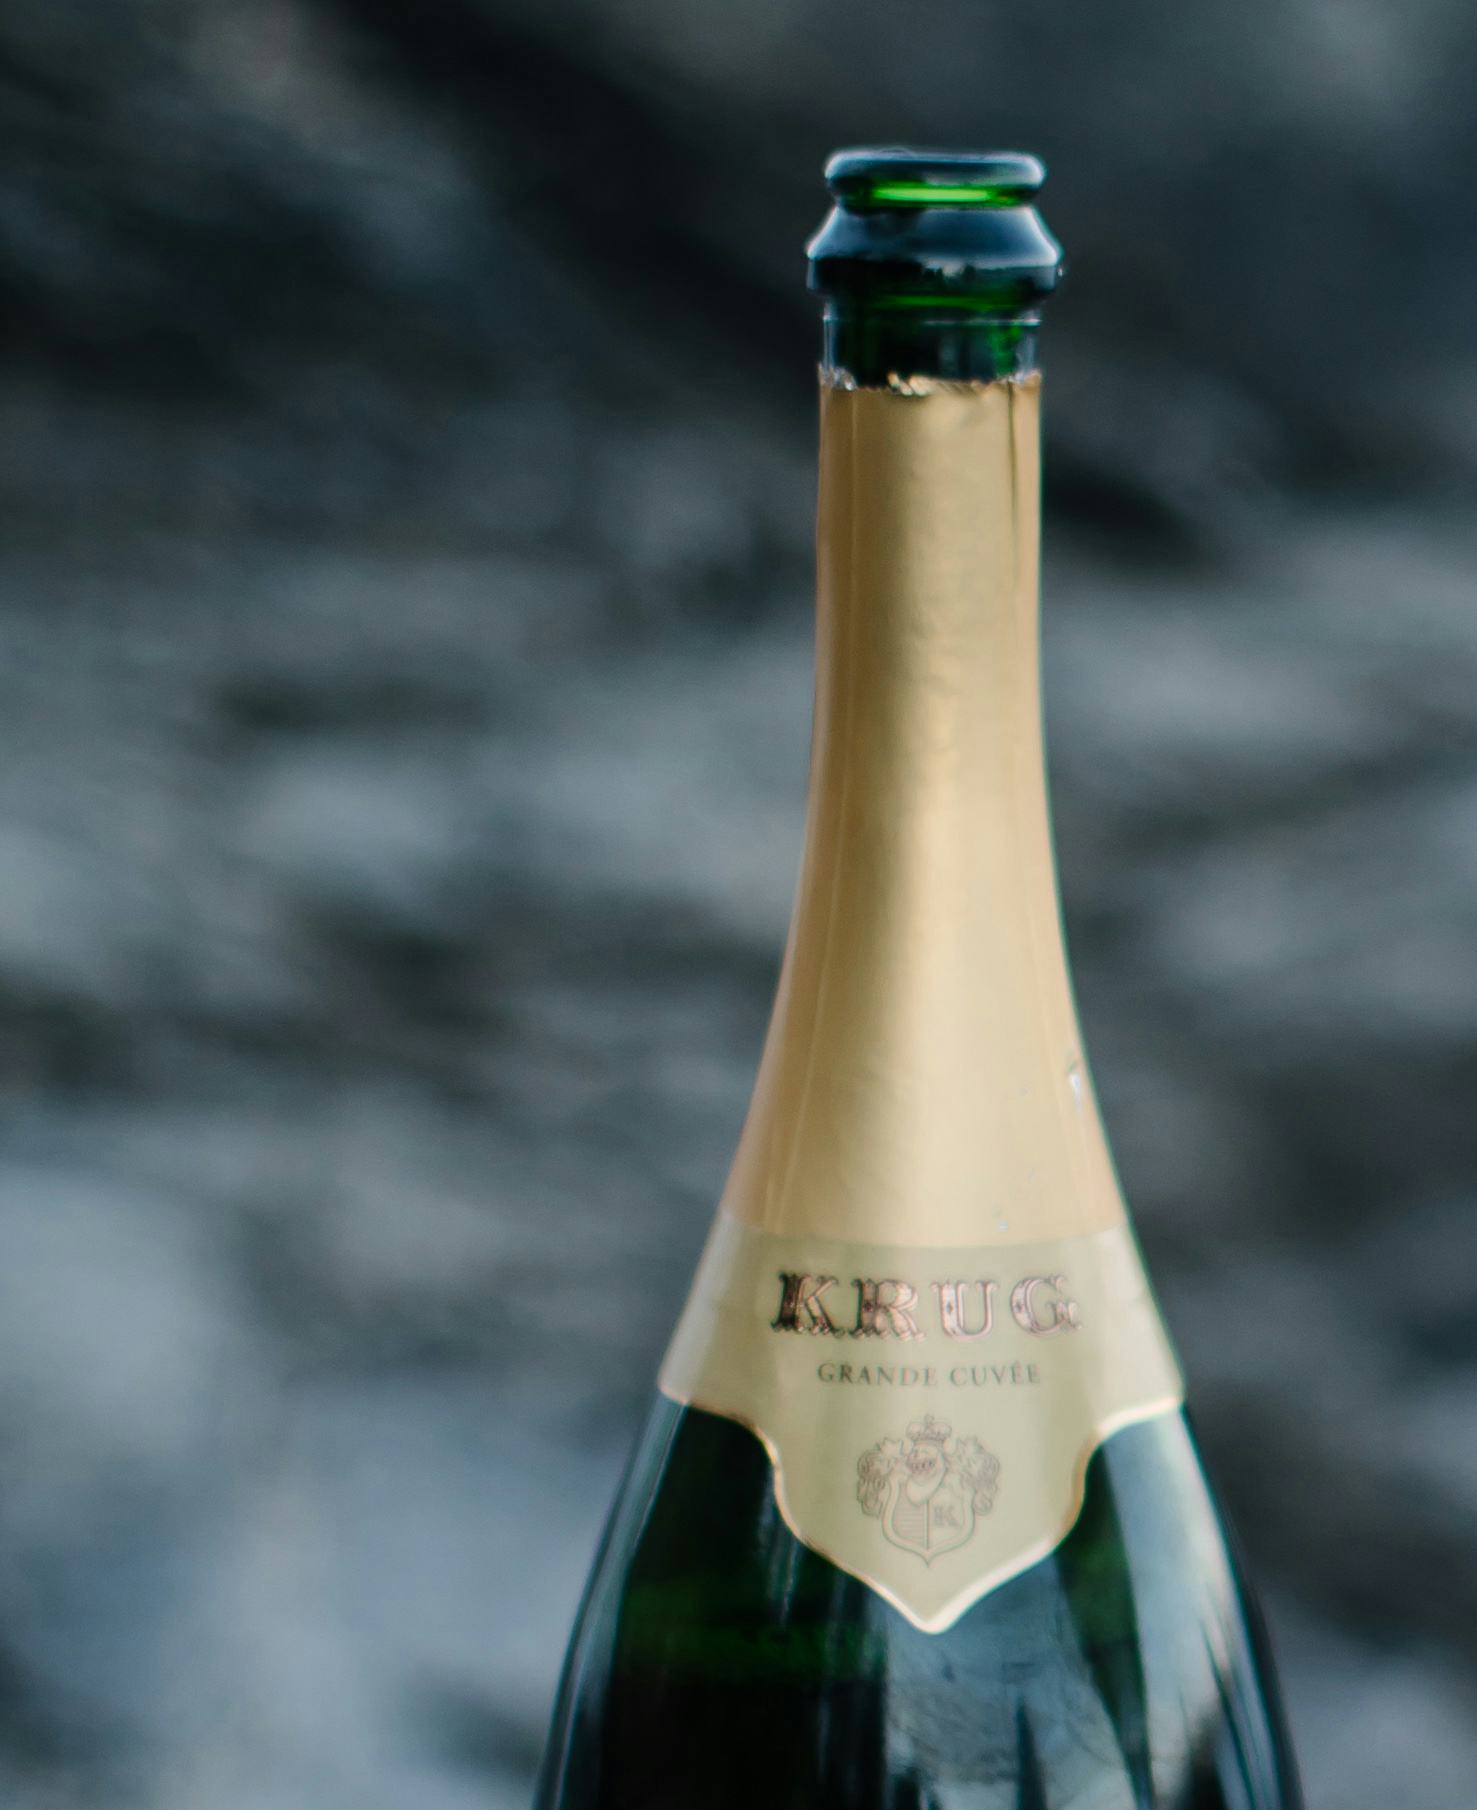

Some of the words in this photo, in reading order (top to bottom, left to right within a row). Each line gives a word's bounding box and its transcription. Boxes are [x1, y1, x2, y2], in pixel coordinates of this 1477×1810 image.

[770, 1271, 1082, 1342] KRUG
[817, 1361, 938, 1387] GRANDE
[950, 1359, 1041, 1387] CUVÉE
